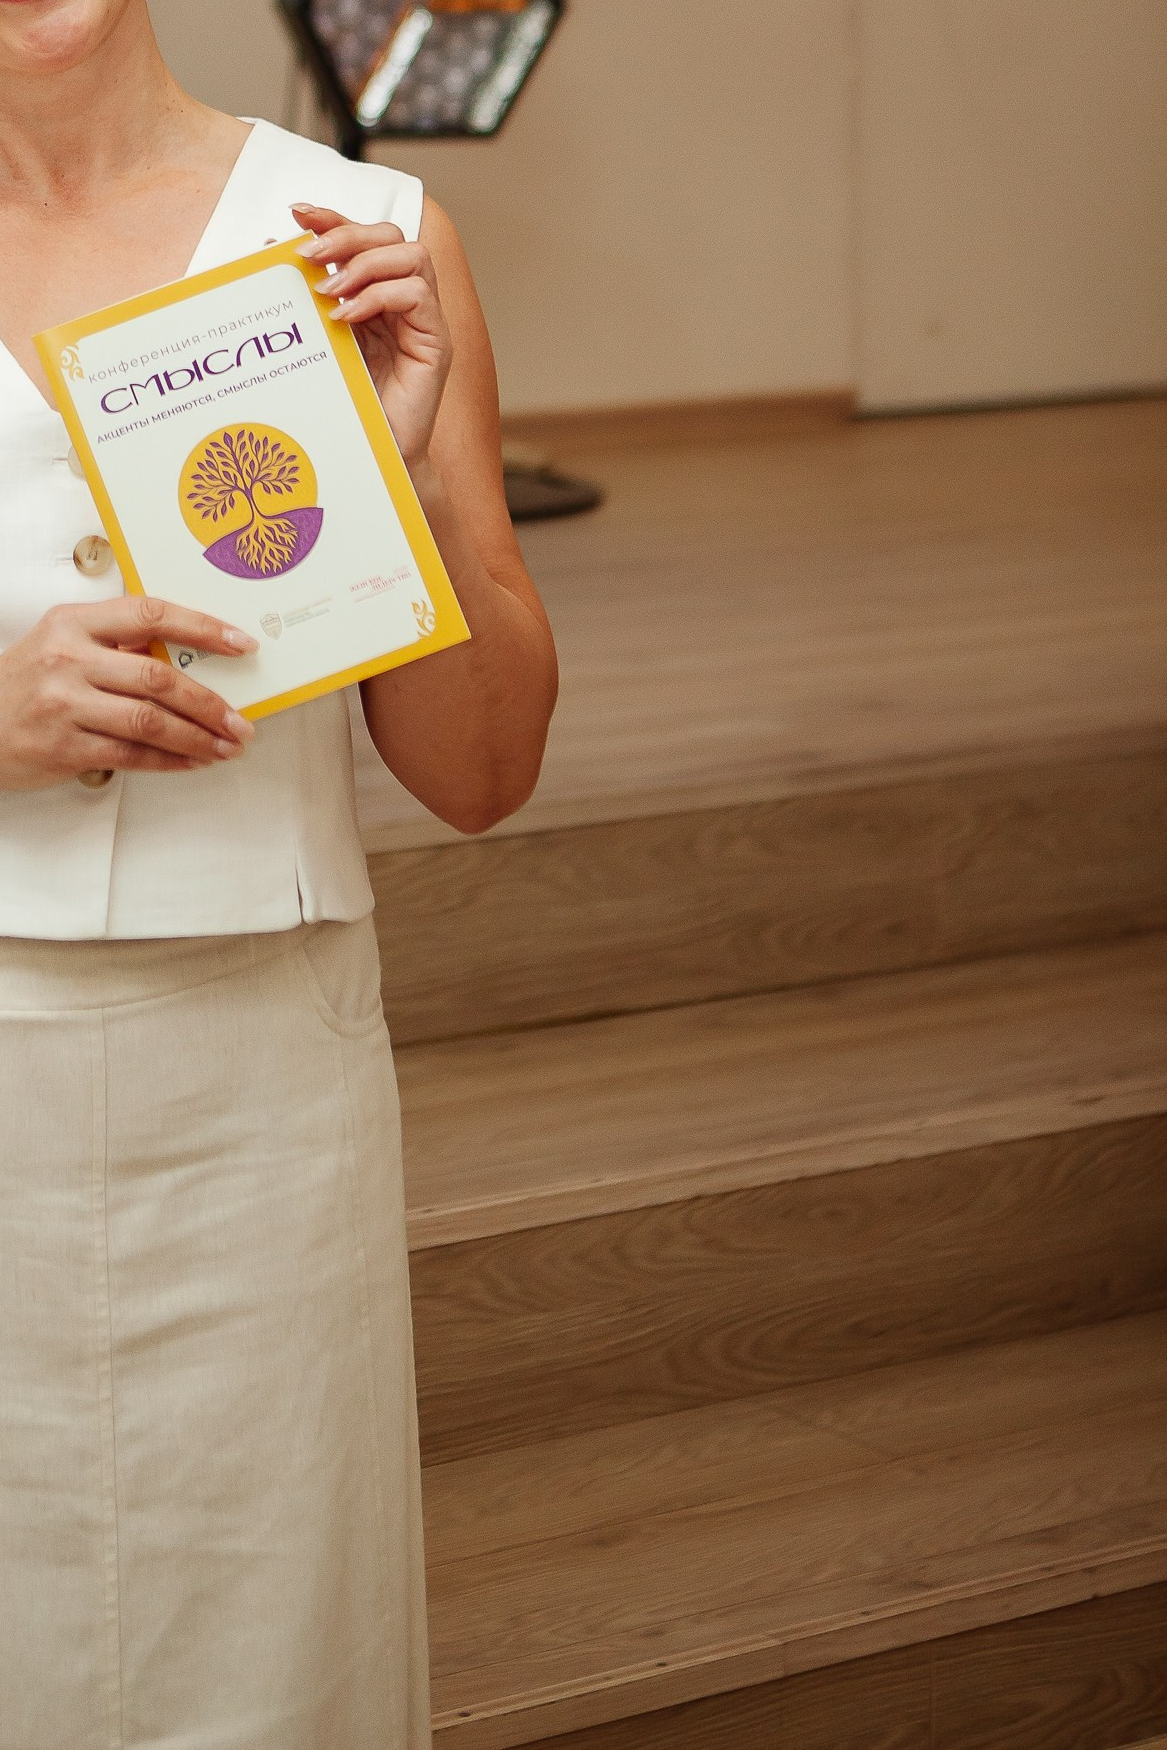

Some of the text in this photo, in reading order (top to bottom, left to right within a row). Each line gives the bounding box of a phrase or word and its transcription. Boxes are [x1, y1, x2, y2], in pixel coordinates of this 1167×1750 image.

[88, 300, 294, 384] конференция-практикум
[100, 322, 304, 414] СМЫСЛЫ
[97, 350, 328, 444] АКЦЕНТЫ МЕНЯЮТСЯ, СМЫСЛЫ ОСТАЮТСЯ
